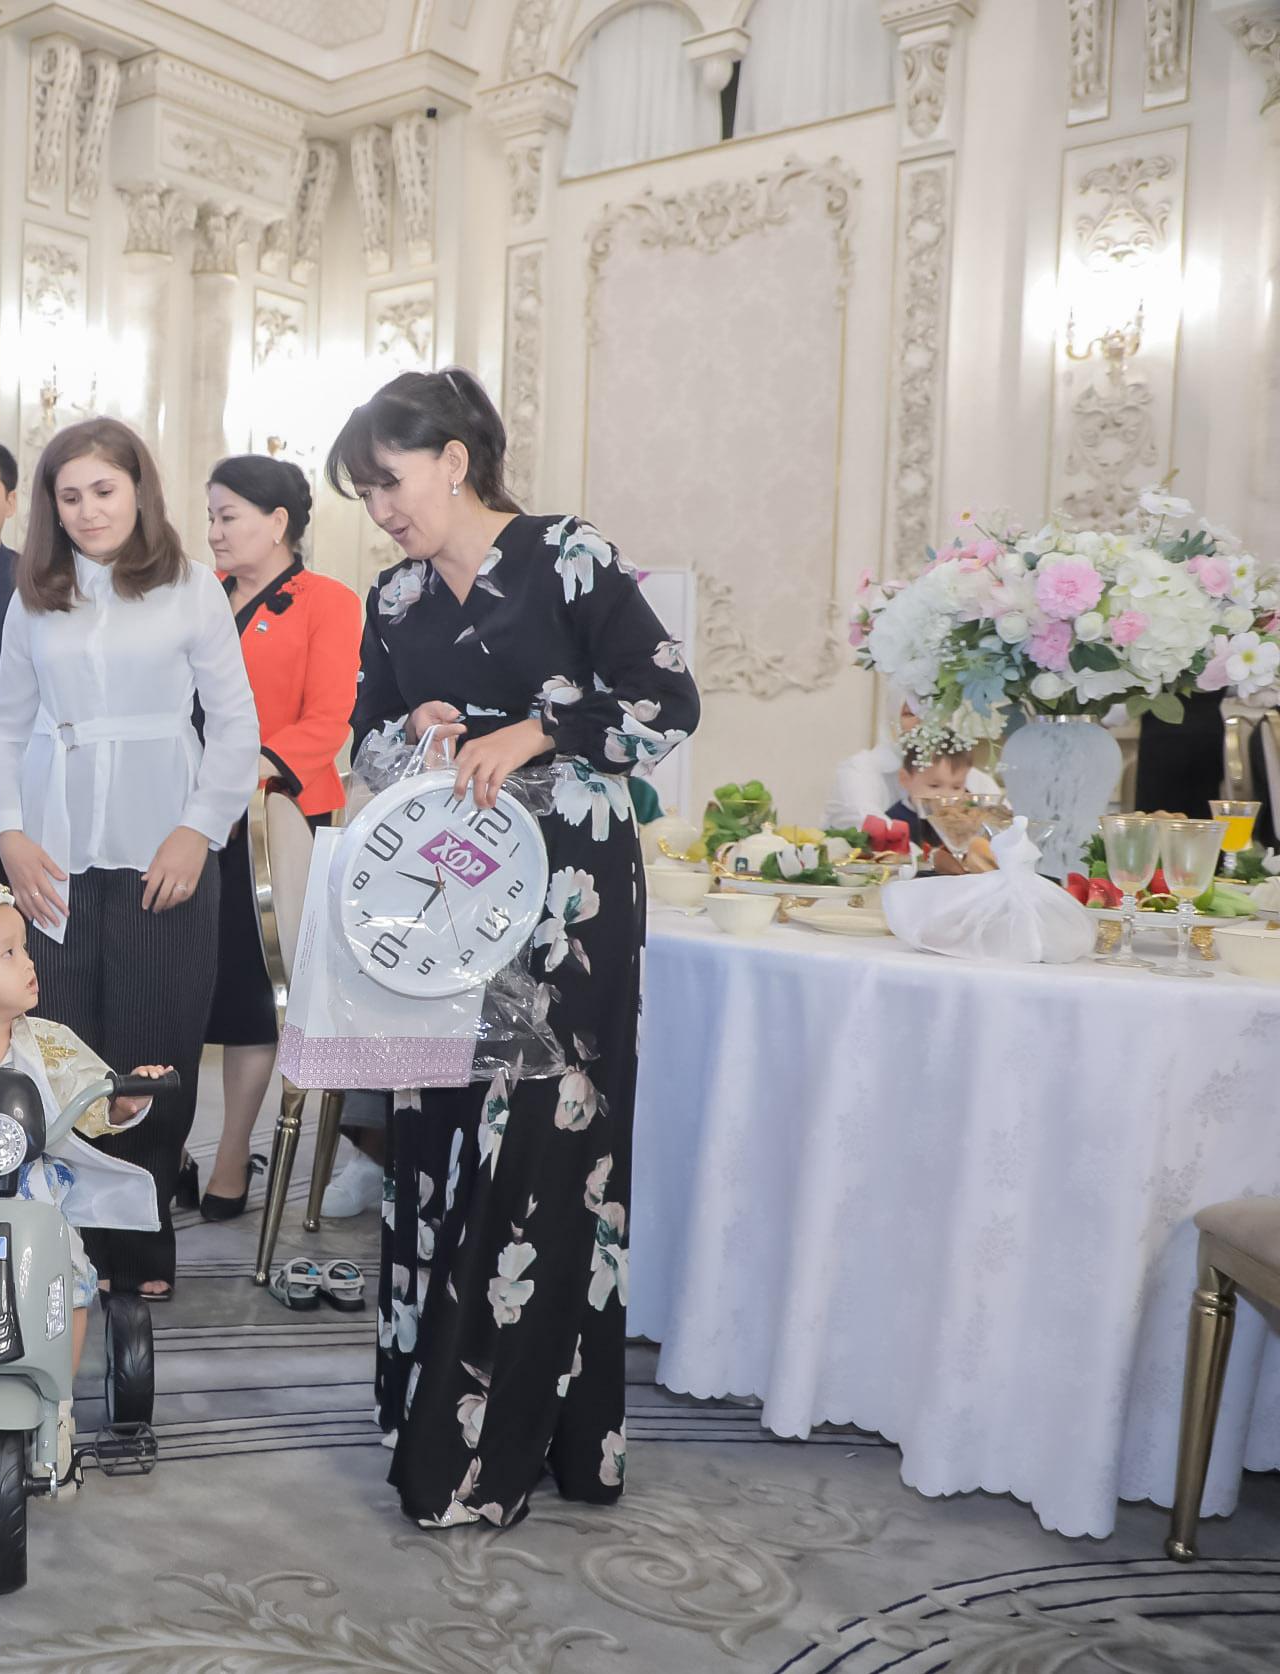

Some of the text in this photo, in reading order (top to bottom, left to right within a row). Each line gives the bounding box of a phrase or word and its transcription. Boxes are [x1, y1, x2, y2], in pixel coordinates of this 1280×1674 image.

[402, 798, 426, 822] 10
[365, 822, 403, 861] 9
[353, 871, 371, 891] 8
[507, 879, 525, 899] 2
[475, 906, 512, 943] 3
[370, 932, 408, 969] 6
[459, 949, 475, 967] 4
[416, 956, 436, 976] 5
